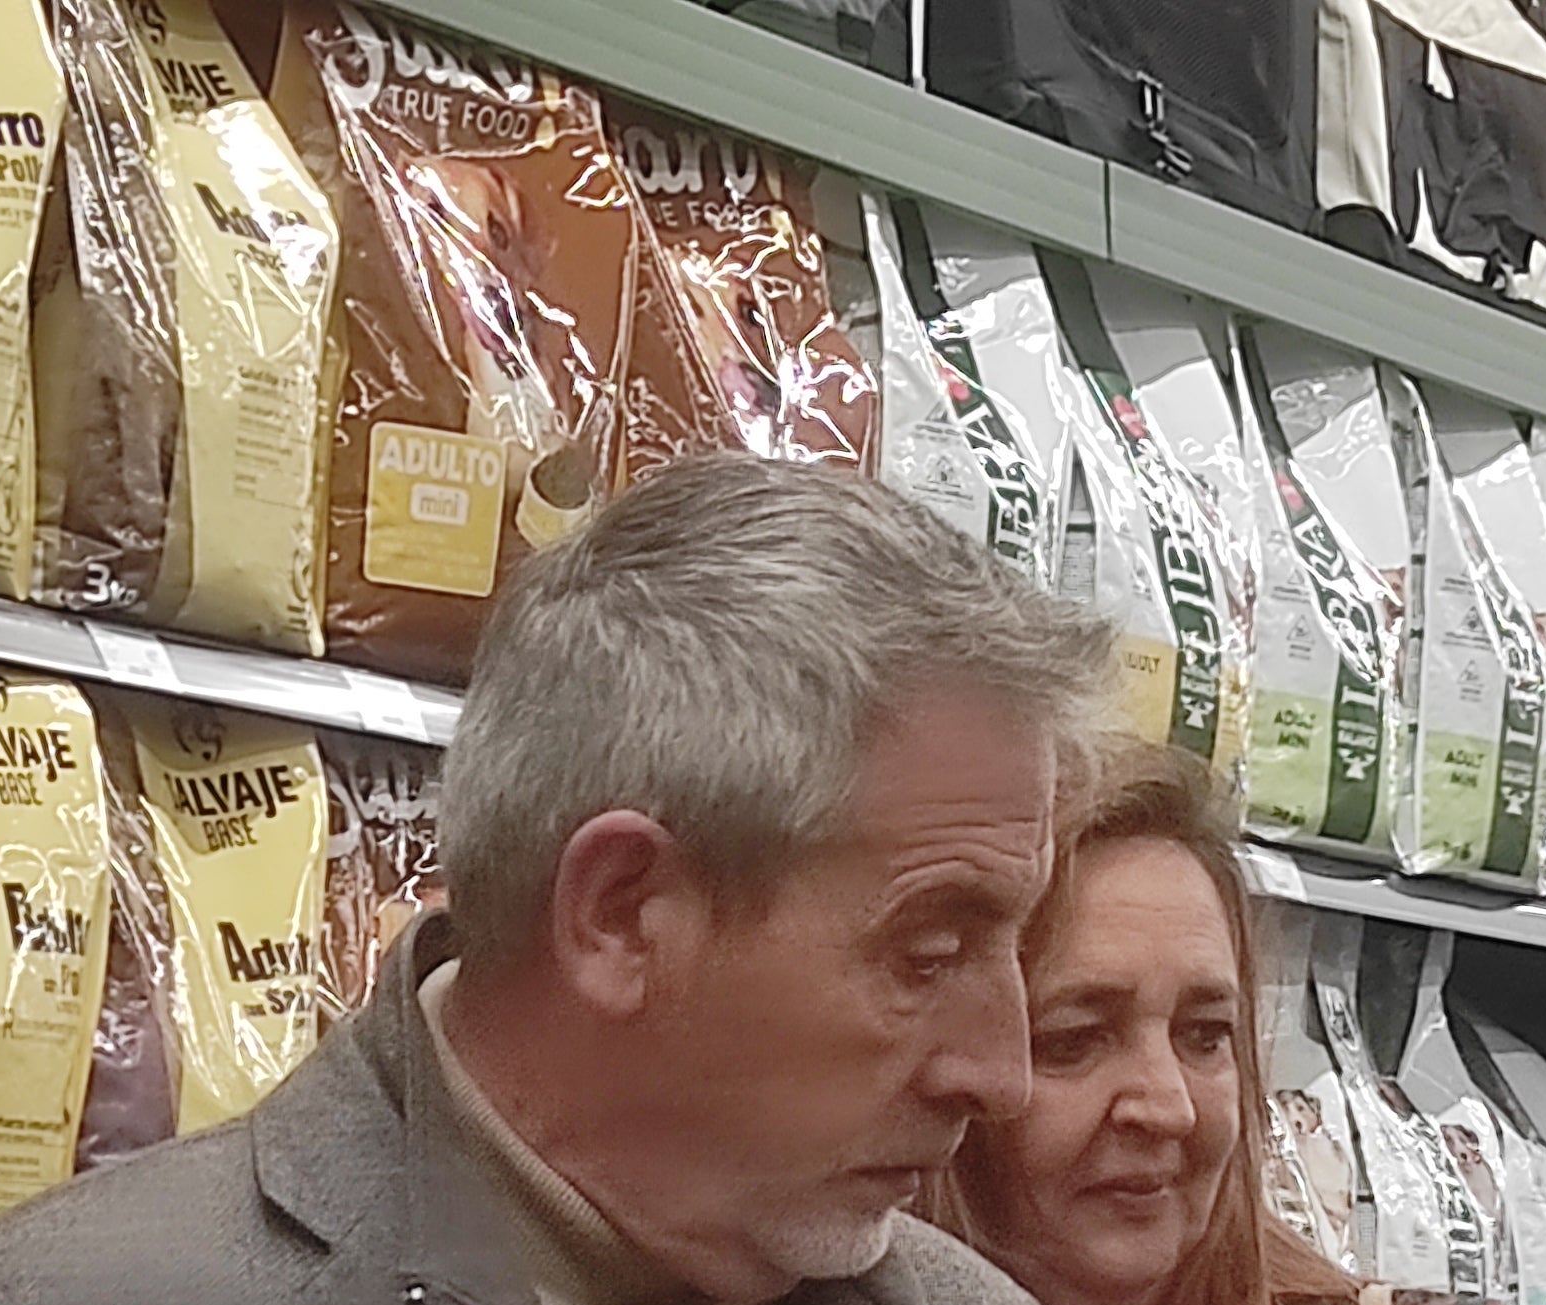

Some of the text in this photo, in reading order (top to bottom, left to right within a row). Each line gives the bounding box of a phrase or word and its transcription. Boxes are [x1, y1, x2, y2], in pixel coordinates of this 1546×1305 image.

[155, 58, 235, 108] VAJE
[387, 85, 531, 140] TRUE FOOD
[378, 434, 501, 488] ADULTO
[204, 817, 258, 851] BASE
